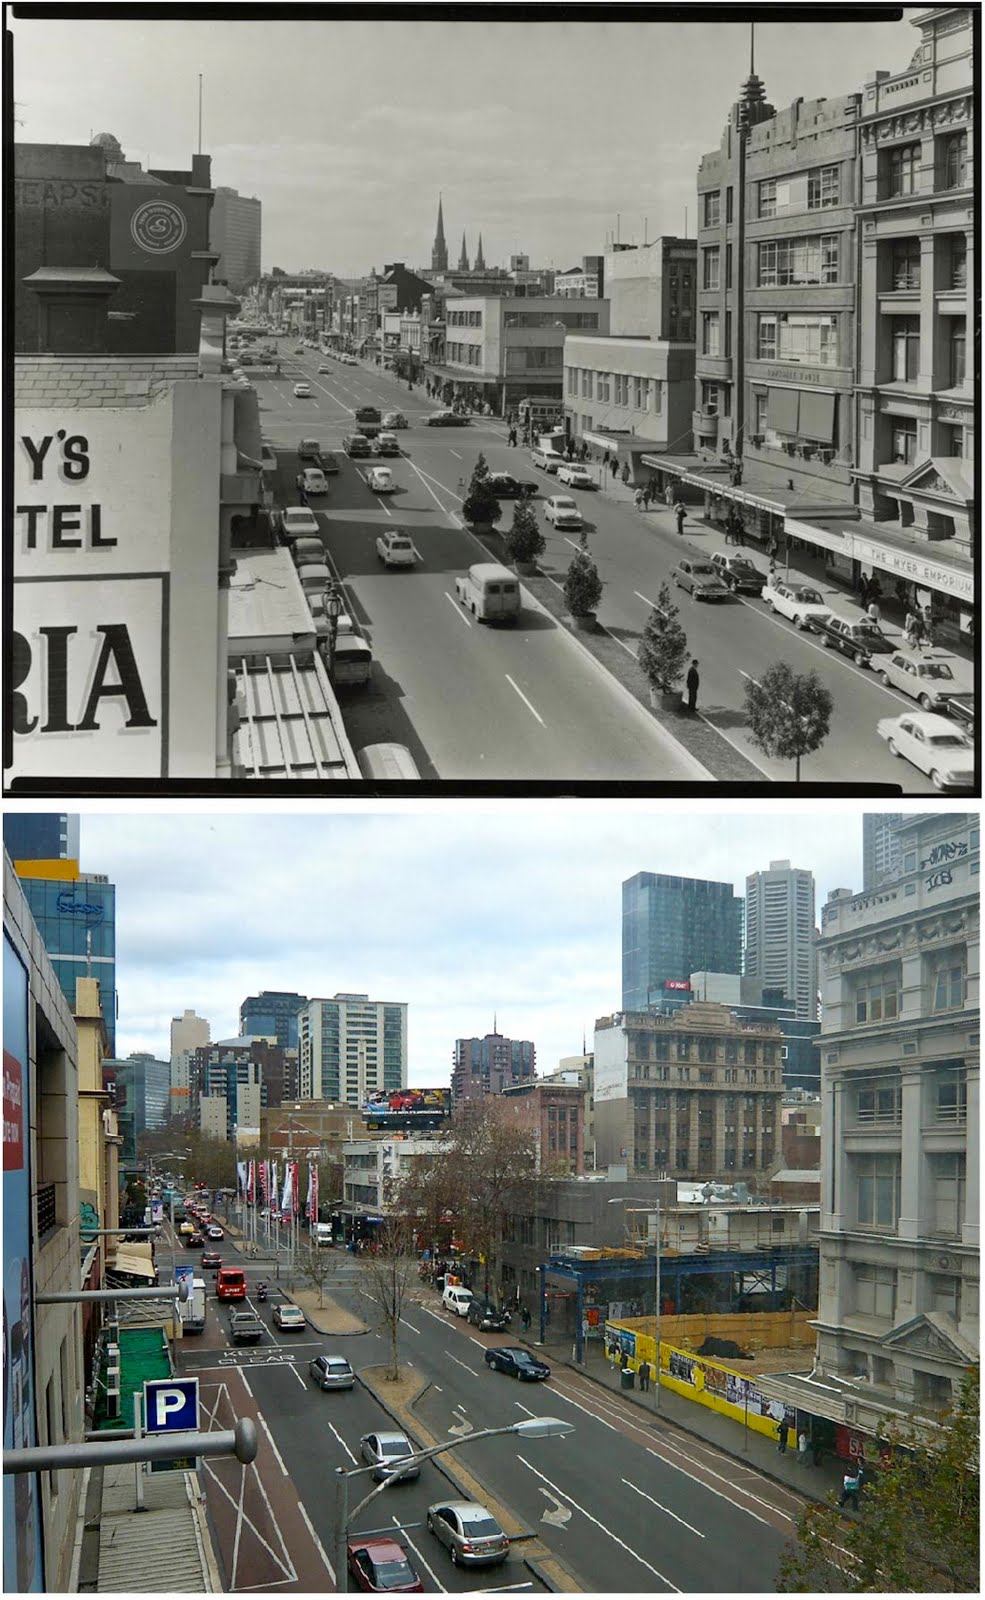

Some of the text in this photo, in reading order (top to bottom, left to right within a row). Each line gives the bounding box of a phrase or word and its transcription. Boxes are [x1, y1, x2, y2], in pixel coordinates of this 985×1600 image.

[21, 429, 90, 480] Y'S
[16, 504, 118, 548] TEL
[871, 549, 972, 595] THE MYER EMPORIUM
[218, 1354, 297, 1364] CLEAR
[223, 1348, 283, 1358] KEEP
[156, 1388, 187, 1426] P
